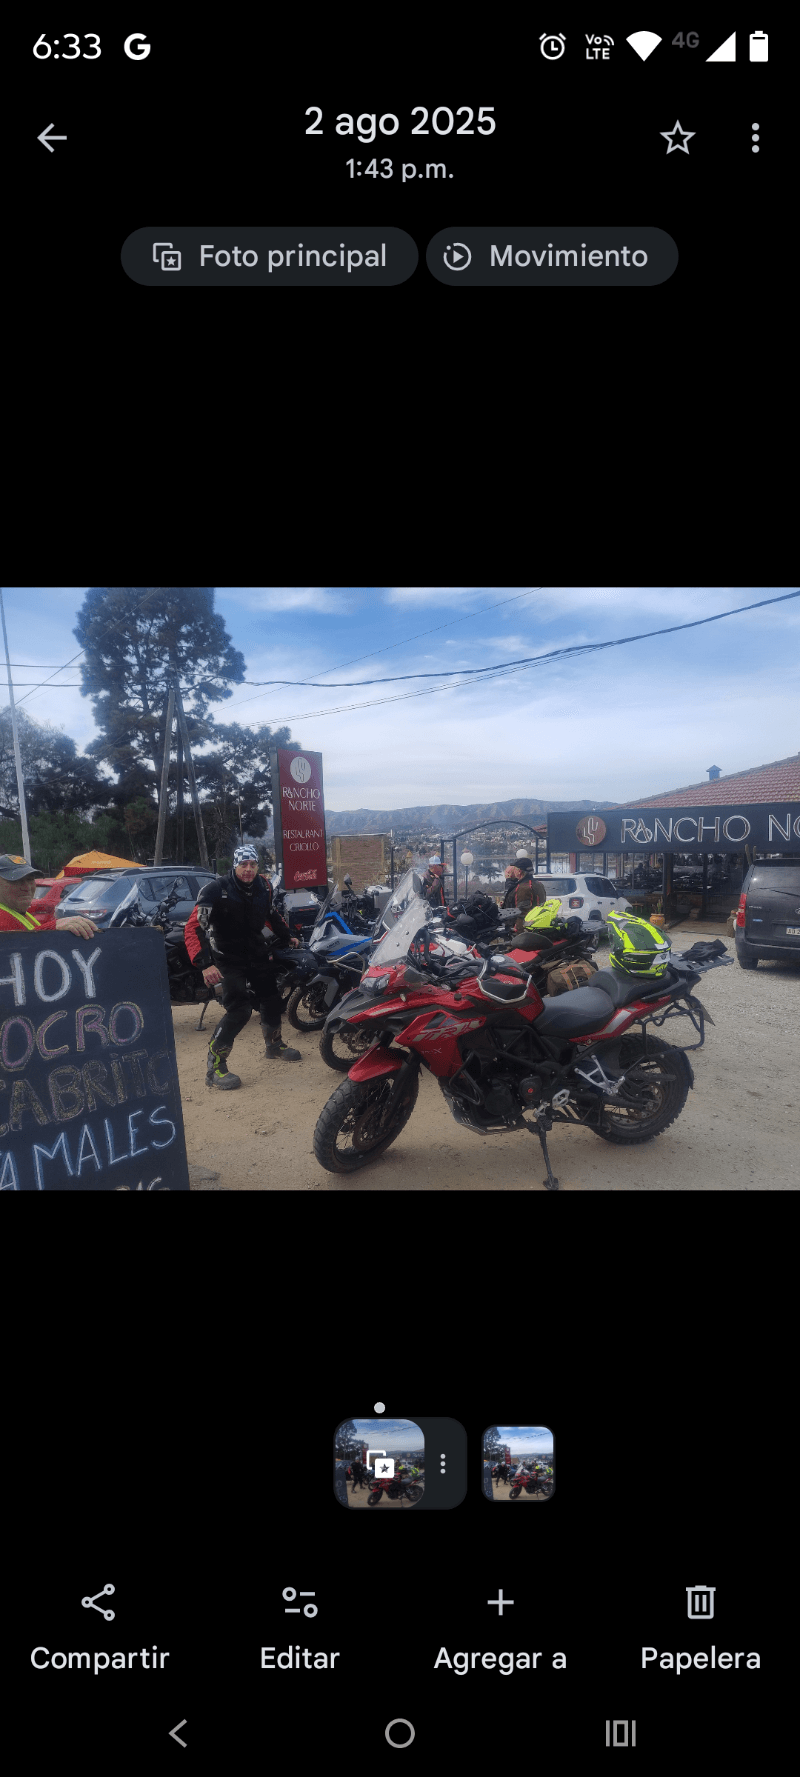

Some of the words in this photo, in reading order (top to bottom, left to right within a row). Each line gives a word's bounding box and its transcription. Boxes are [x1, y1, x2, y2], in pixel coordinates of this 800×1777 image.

[282, 787, 320, 799] RANCHO
[288, 800, 316, 811] NORTE
[283, 829, 323, 839] RESTAURANT
[620, 814, 751, 844] RANCHO
[289, 841, 319, 852] CRIOLLO
[0, 946, 102, 1007] HOY
[0, 1000, 145, 1073] OCRO
[0, 1105, 176, 1191] AMALES
